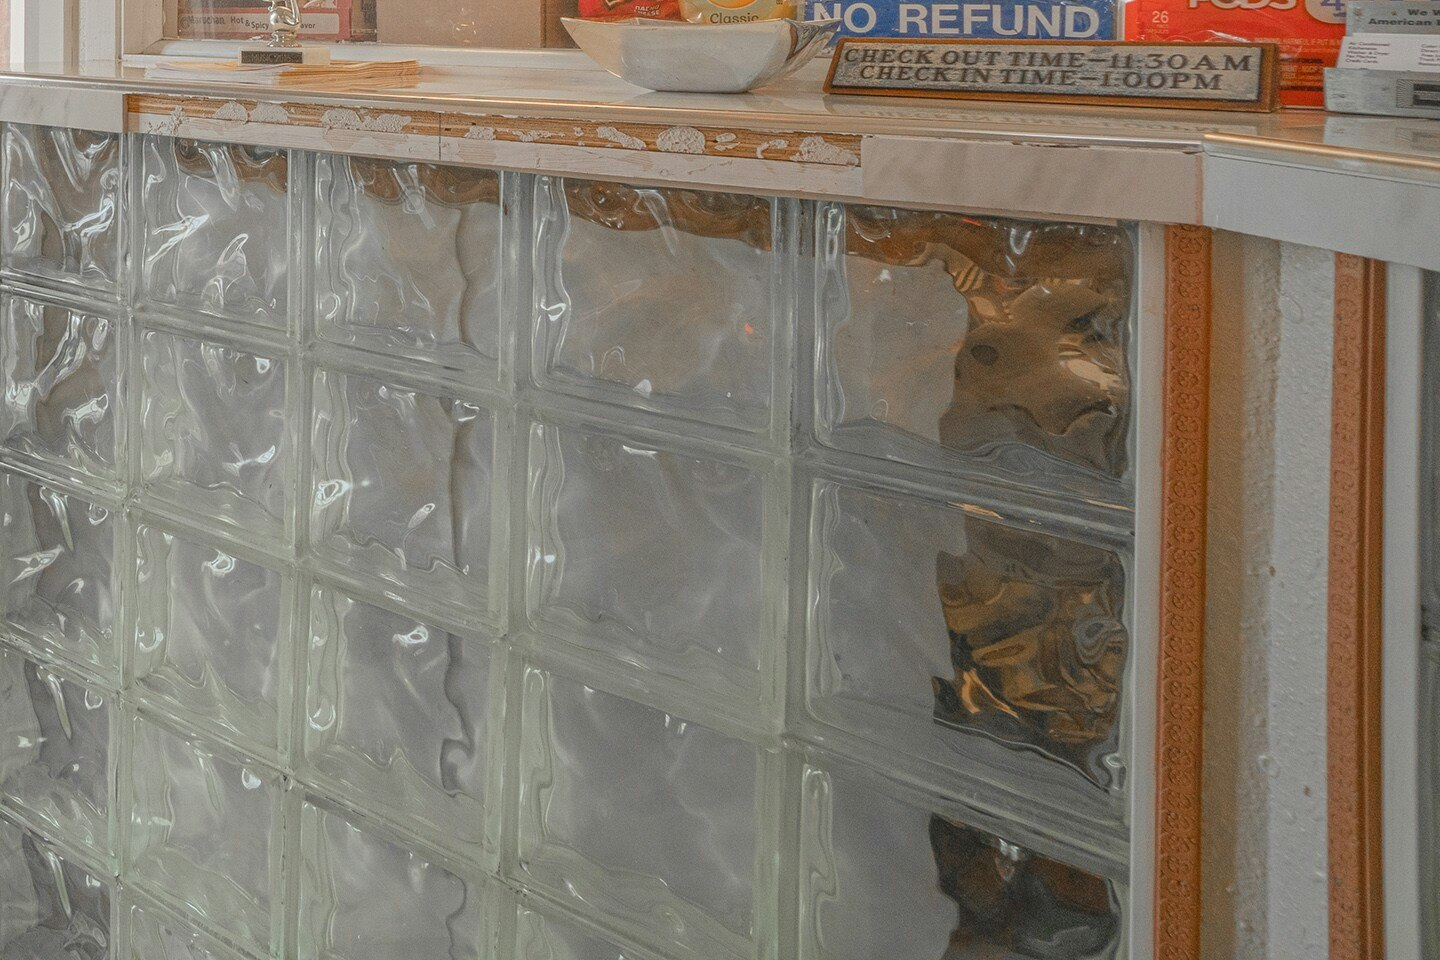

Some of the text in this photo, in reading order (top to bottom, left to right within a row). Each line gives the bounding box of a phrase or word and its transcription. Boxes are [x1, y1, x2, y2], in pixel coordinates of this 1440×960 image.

[1152, 11, 1169, 23] 26
[1408, 8, 1427, 16] We
[231, 16, 244, 24] Hot
[709, 13, 759, 23] Classic
[813, 2, 1100, 38] NO REFUND
[1368, 17, 1431, 26] American
[844, 48, 934, 64] CHECK
[940, 50, 1001, 66] OUT
[860, 65, 951, 83] CHECK
[958, 67, 998, 84] IN
